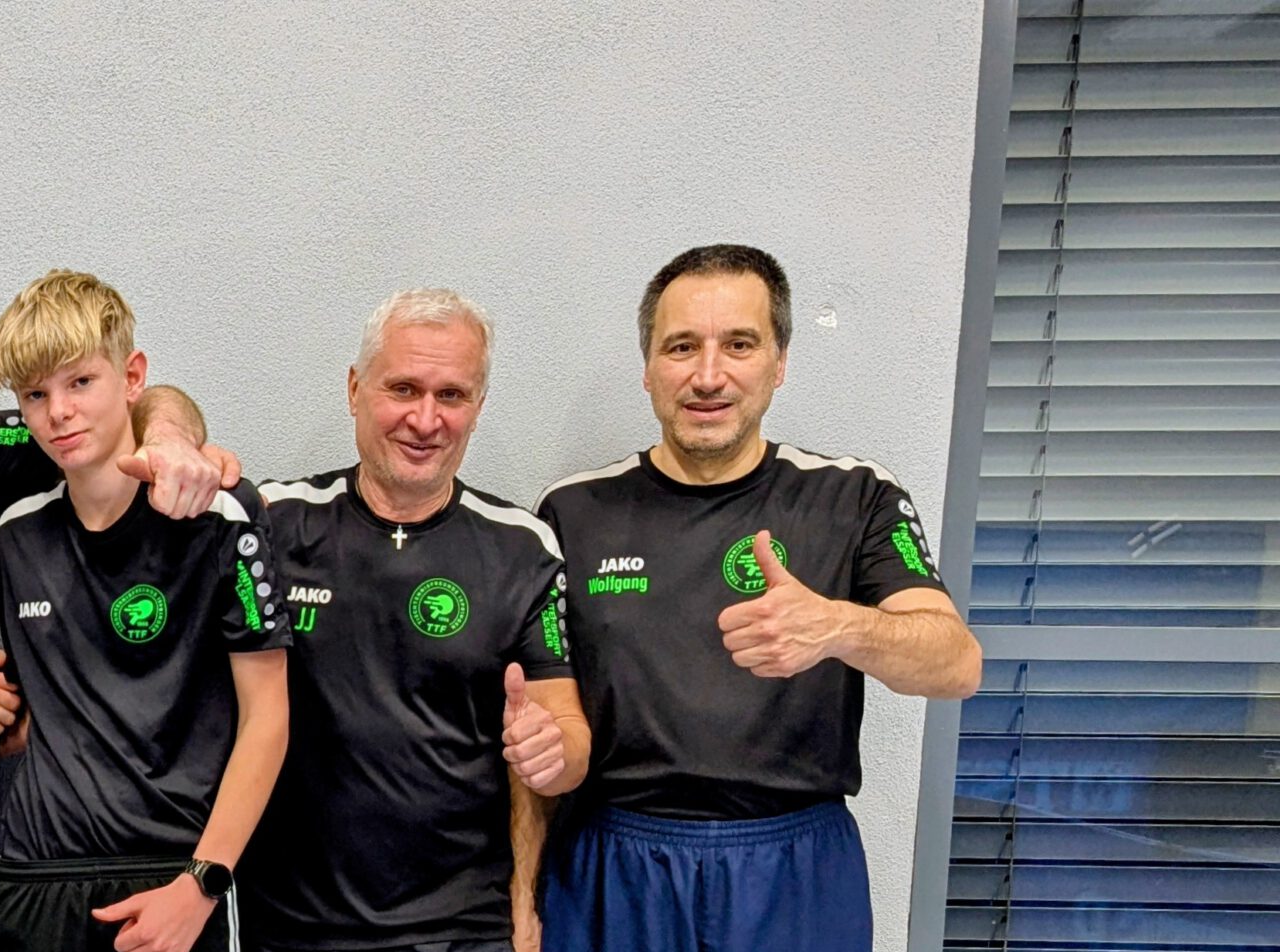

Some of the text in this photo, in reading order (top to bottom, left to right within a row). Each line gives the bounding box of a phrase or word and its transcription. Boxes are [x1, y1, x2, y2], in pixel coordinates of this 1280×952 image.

[598, 556, 645, 573] JAKO
[588, 575, 648, 595] Wolfgang
[286, 586, 332, 604] JAKO
[19, 600, 52, 619] JAKO
[294, 607, 317, 632] JJ
[427, 623, 448, 633] TTF
[128, 629, 148, 638] TTF
